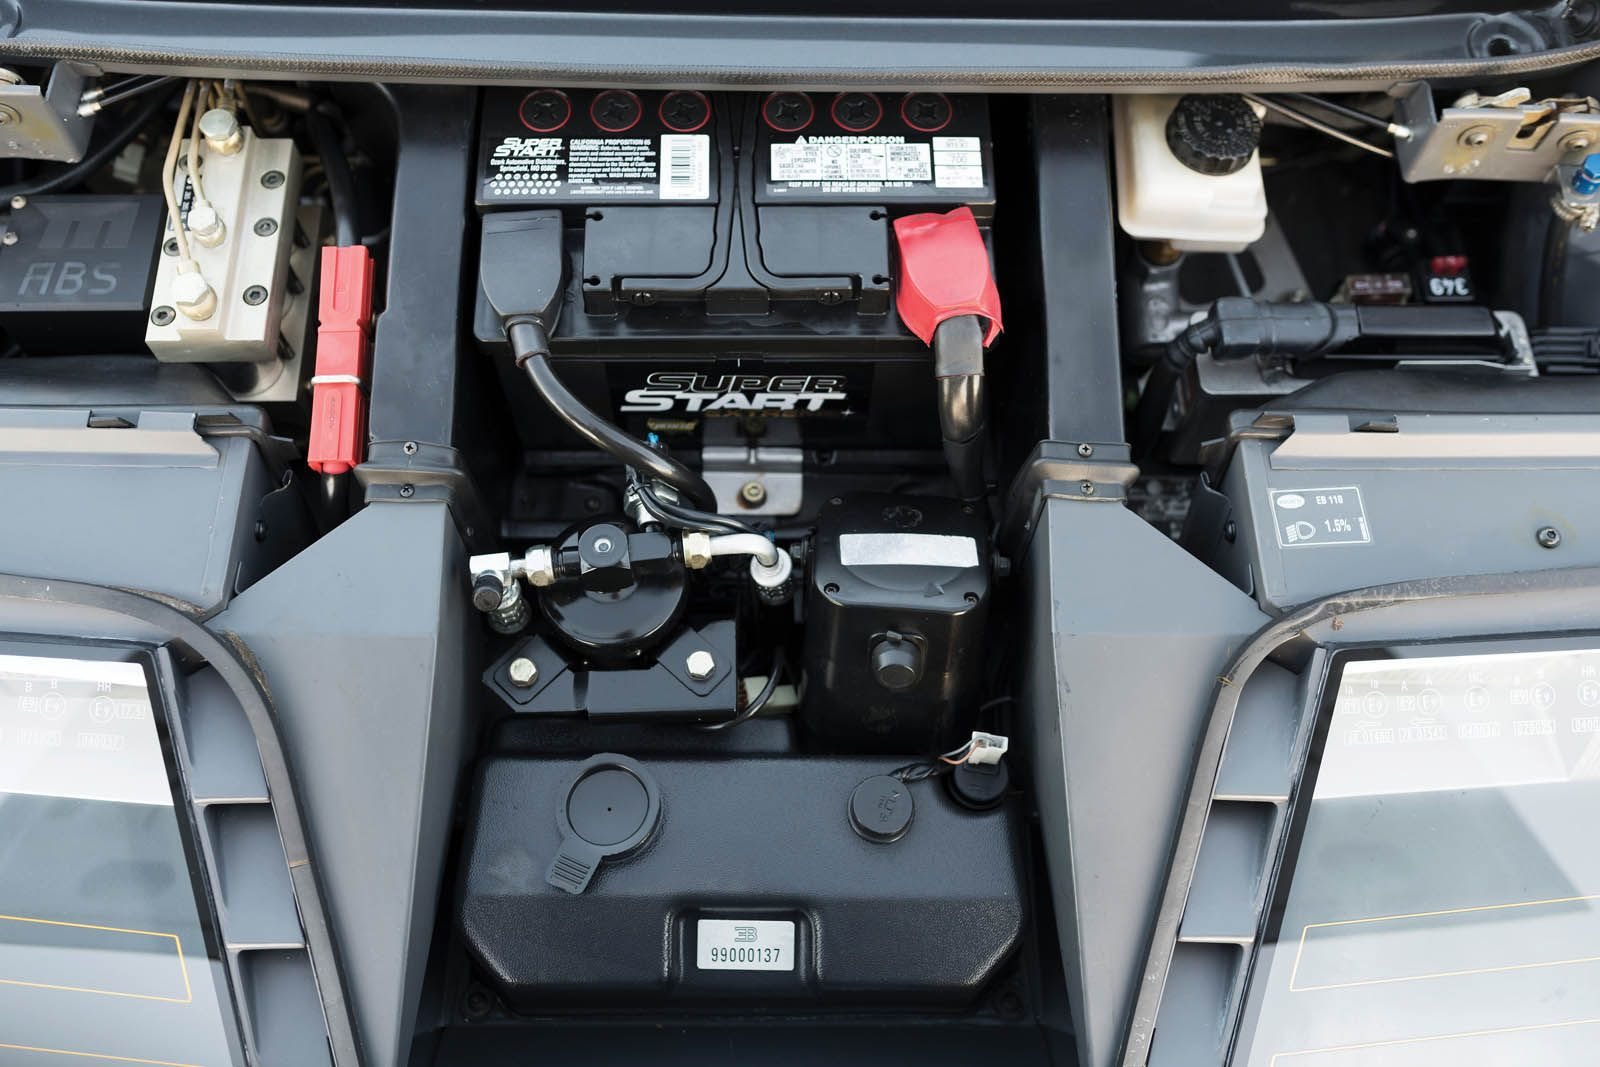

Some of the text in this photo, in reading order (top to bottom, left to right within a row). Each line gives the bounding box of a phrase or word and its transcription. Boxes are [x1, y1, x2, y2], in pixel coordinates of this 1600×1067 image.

[503, 137, 562, 148] SUPER
[808, 136, 905, 144] DANGER/POISON
[493, 145, 563, 157] START
[17, 261, 121, 296] ABS
[643, 372, 847, 393] SUPER
[620, 389, 847, 412] START
[1315, 495, 1327, 505] EB
[1324, 518, 1352, 533] 1.5%
[711, 947, 781, 963] 99000137
